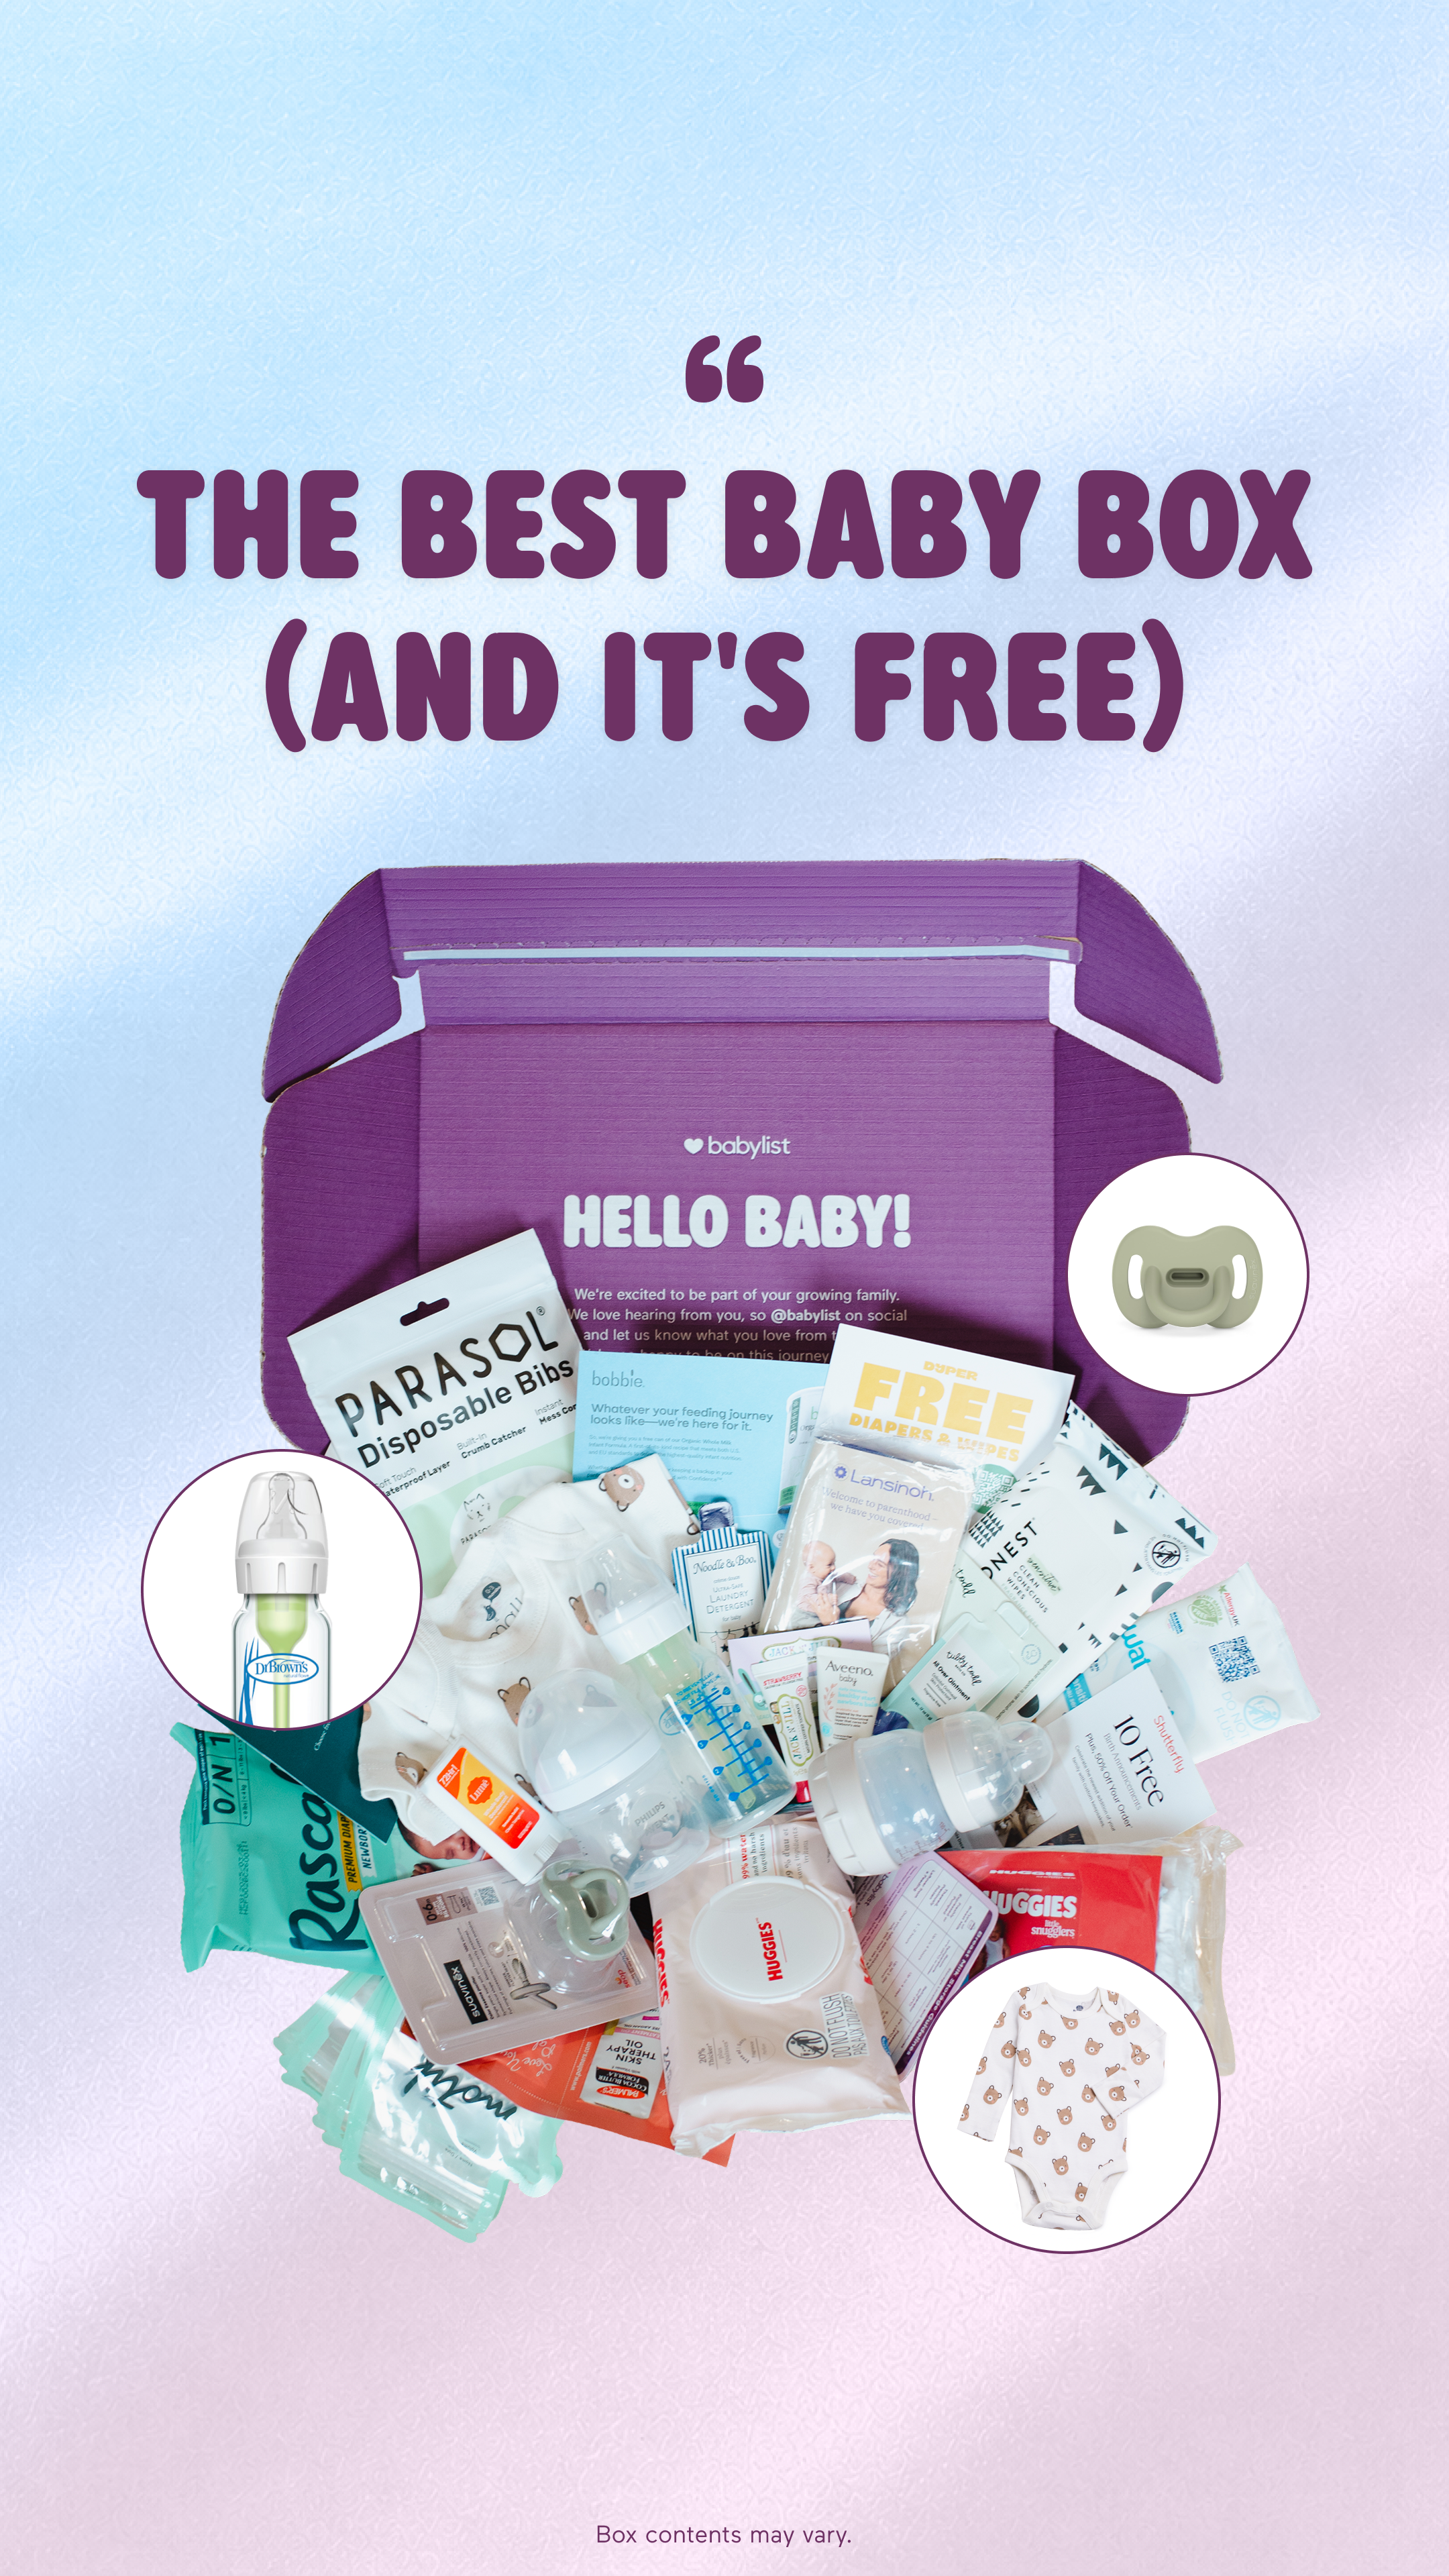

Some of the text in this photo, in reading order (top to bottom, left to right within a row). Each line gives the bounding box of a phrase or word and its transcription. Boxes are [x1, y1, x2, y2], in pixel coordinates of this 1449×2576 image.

[708, 1136, 791, 1159] babylist
[564, 1193, 912, 1248] HELLO BABY!
[574, 1288, 900, 1306] We're excited to be part of your growing family.
[568, 1308, 908, 1326] We love hearing from you, so @babylist on social
[584, 1328, 833, 1345] and let us know what you love from
[749, 1348, 829, 1364] this journey
[923, 1360, 978, 1381] DYPER
[358, 1360, 574, 1468] Disposable Bibs
[535, 1399, 564, 1416] Instant
[592, 1403, 773, 1422] Whatever your feeding journey
[853, 1362, 1034, 1444] FREE
[539, 1410, 561, 1425] Mess
[590, 1415, 621, 1426] looks
[692, 1419, 718, 1430] here
[722, 1419, 738, 1431] for
[457, 1432, 487, 1450] Built-In
[461, 1425, 527, 1460] Crumb Catcher
[849, 1413, 1020, 1462] DIAPERS & WIPES
[385, 1460, 450, 1497] aterproof Layer
[396, 1466, 417, 1483] Touch
[822, 1487, 930, 1521] Welcome to parenthood
[830, 1503, 885, 1523] we have you
[977, 1520, 1042, 1580] ONEST
[691, 1558, 725, 1574] Noodle
[1018, 1564, 1040, 1589] CLEAN
[955, 1568, 976, 1598] todd
[1004, 1576, 1026, 1601] WIPES
[1010, 1570, 1050, 1613] CONSCIOUS
[706, 1598, 754, 1614] DETERGENT
[709, 1589, 749, 1603] LAUNDRY
[947, 1650, 968, 1668] tubby
[763, 1672, 802, 1686] STRAWBERRY
[838, 1673, 857, 1686] baby
[936, 1665, 971, 1702] Over Ointment
[780, 1700, 802, 1760] JACK JILL
[211, 1736, 232, 1747] 1
[1153, 1715, 1185, 1774] Shutterfly
[1093, 1752, 1108, 1772] 50%
[1102, 1732, 1145, 1811] Birth Announcements
[1112, 1713, 1165, 1808] 10 Free
[1073, 1744, 1110, 1814] Celebrate addition
[1101, 1770, 1114, 1785] Off
[1106, 1784, 1122, 1805] Your
[632, 1801, 667, 1827] PHILIPS
[642, 1813, 672, 1836] AVENT
[270, 1762, 368, 1951] Rasca
[359, 1823, 372, 1870] NEWBOR
[738, 1833, 750, 1878] 99% water
[749, 1831, 760, 1876] and harsh
[755, 1833, 770, 1872] ingredients
[343, 1839, 360, 1884] PREMIUM
[989, 1868, 1075, 1878] HUGGIES
[981, 1889, 1077, 1919] HUGGIES
[1030, 1925, 1075, 1939] snugglers
[1044, 1919, 1059, 1927] little
[759, 1921, 784, 1982] HUGGIES
[906, 1929, 983, 2057] Breast Milk Storage Guidelines
[820, 1992, 852, 2058] DO NOT FLUSH
[849, 2026, 865, 2043] AUX
[605, 2041, 657, 2063] THERAPY
[624, 2038, 643, 2049] OIL
[851, 2041, 867, 2055] PAS
[519, 2052, 554, 2080] Love
[614, 2052, 643, 2066] SKIN
[697, 2047, 707, 2063] 20%
[597, 2073, 647, 2092] COCOA BUTTER
[606, 2069, 640, 2084] FORMULA
